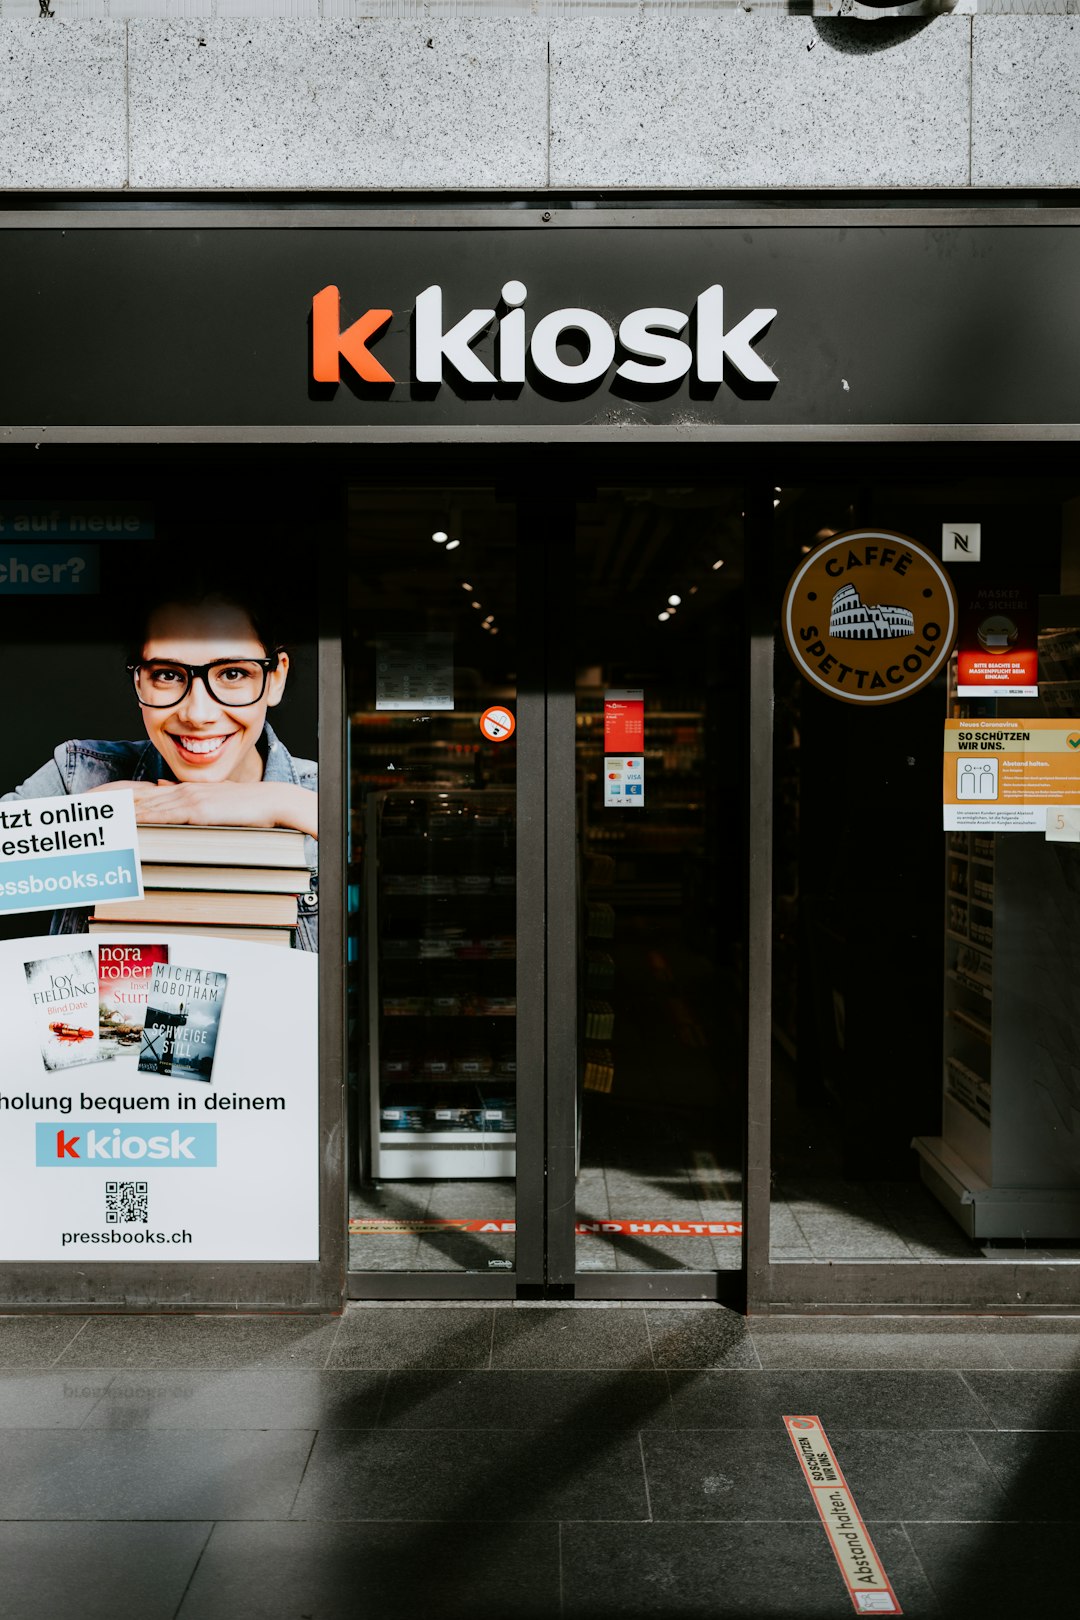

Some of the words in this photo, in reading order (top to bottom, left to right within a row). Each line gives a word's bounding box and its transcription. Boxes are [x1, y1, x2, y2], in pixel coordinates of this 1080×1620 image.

[313, 285, 395, 382] k
[415, 280, 779, 384] kiosk
[14, 510, 61, 532] auf
[70, 515, 140, 532] neue
[977, 589, 1020, 599] MASKE?
[800, 622, 941, 689] SPETTACOLO
[958, 732, 973, 741] SO
[975, 730, 1030, 741] SCHÜTZEN
[958, 742, 978, 750] WIR
[980, 742, 1005, 750] UNS.
[39, 800, 114, 826] online
[1056, 814, 1065, 830] 5
[100, 947, 142, 962] nora
[100, 961, 154, 980] rober
[156, 965, 219, 987] MICHAEL
[50, 974, 74, 989] JOY
[153, 980, 218, 1002] ROBOTHAM
[33, 982, 97, 1005] FIELDING
[47, 1003, 68, 1015] Blind
[68, 1001, 88, 1012] Date
[152, 1023, 208, 1045] SCHWEIGE
[162, 1041, 191, 1057] STILL
[0, 1092, 72, 1114] holung
[80, 1092, 170, 1114] bequem
[178, 1092, 197, 1110] in
[204, 1092, 286, 1110] deinem
[57, 1129, 81, 1158] k
[87, 1128, 196, 1159] kiosk
[575, 1223, 623, 1232] ND
[61, 1229, 193, 1246] pressbooks.ch
[798, 1437, 821, 1471] SCHÜTZEN
[817, 1451, 831, 1467] UNS.
[813, 1471, 825, 1481] SO
[825, 1467, 837, 1481] WIR
[830, 1491, 851, 1530] halten.
[838, 1532, 878, 1585] Abstand
